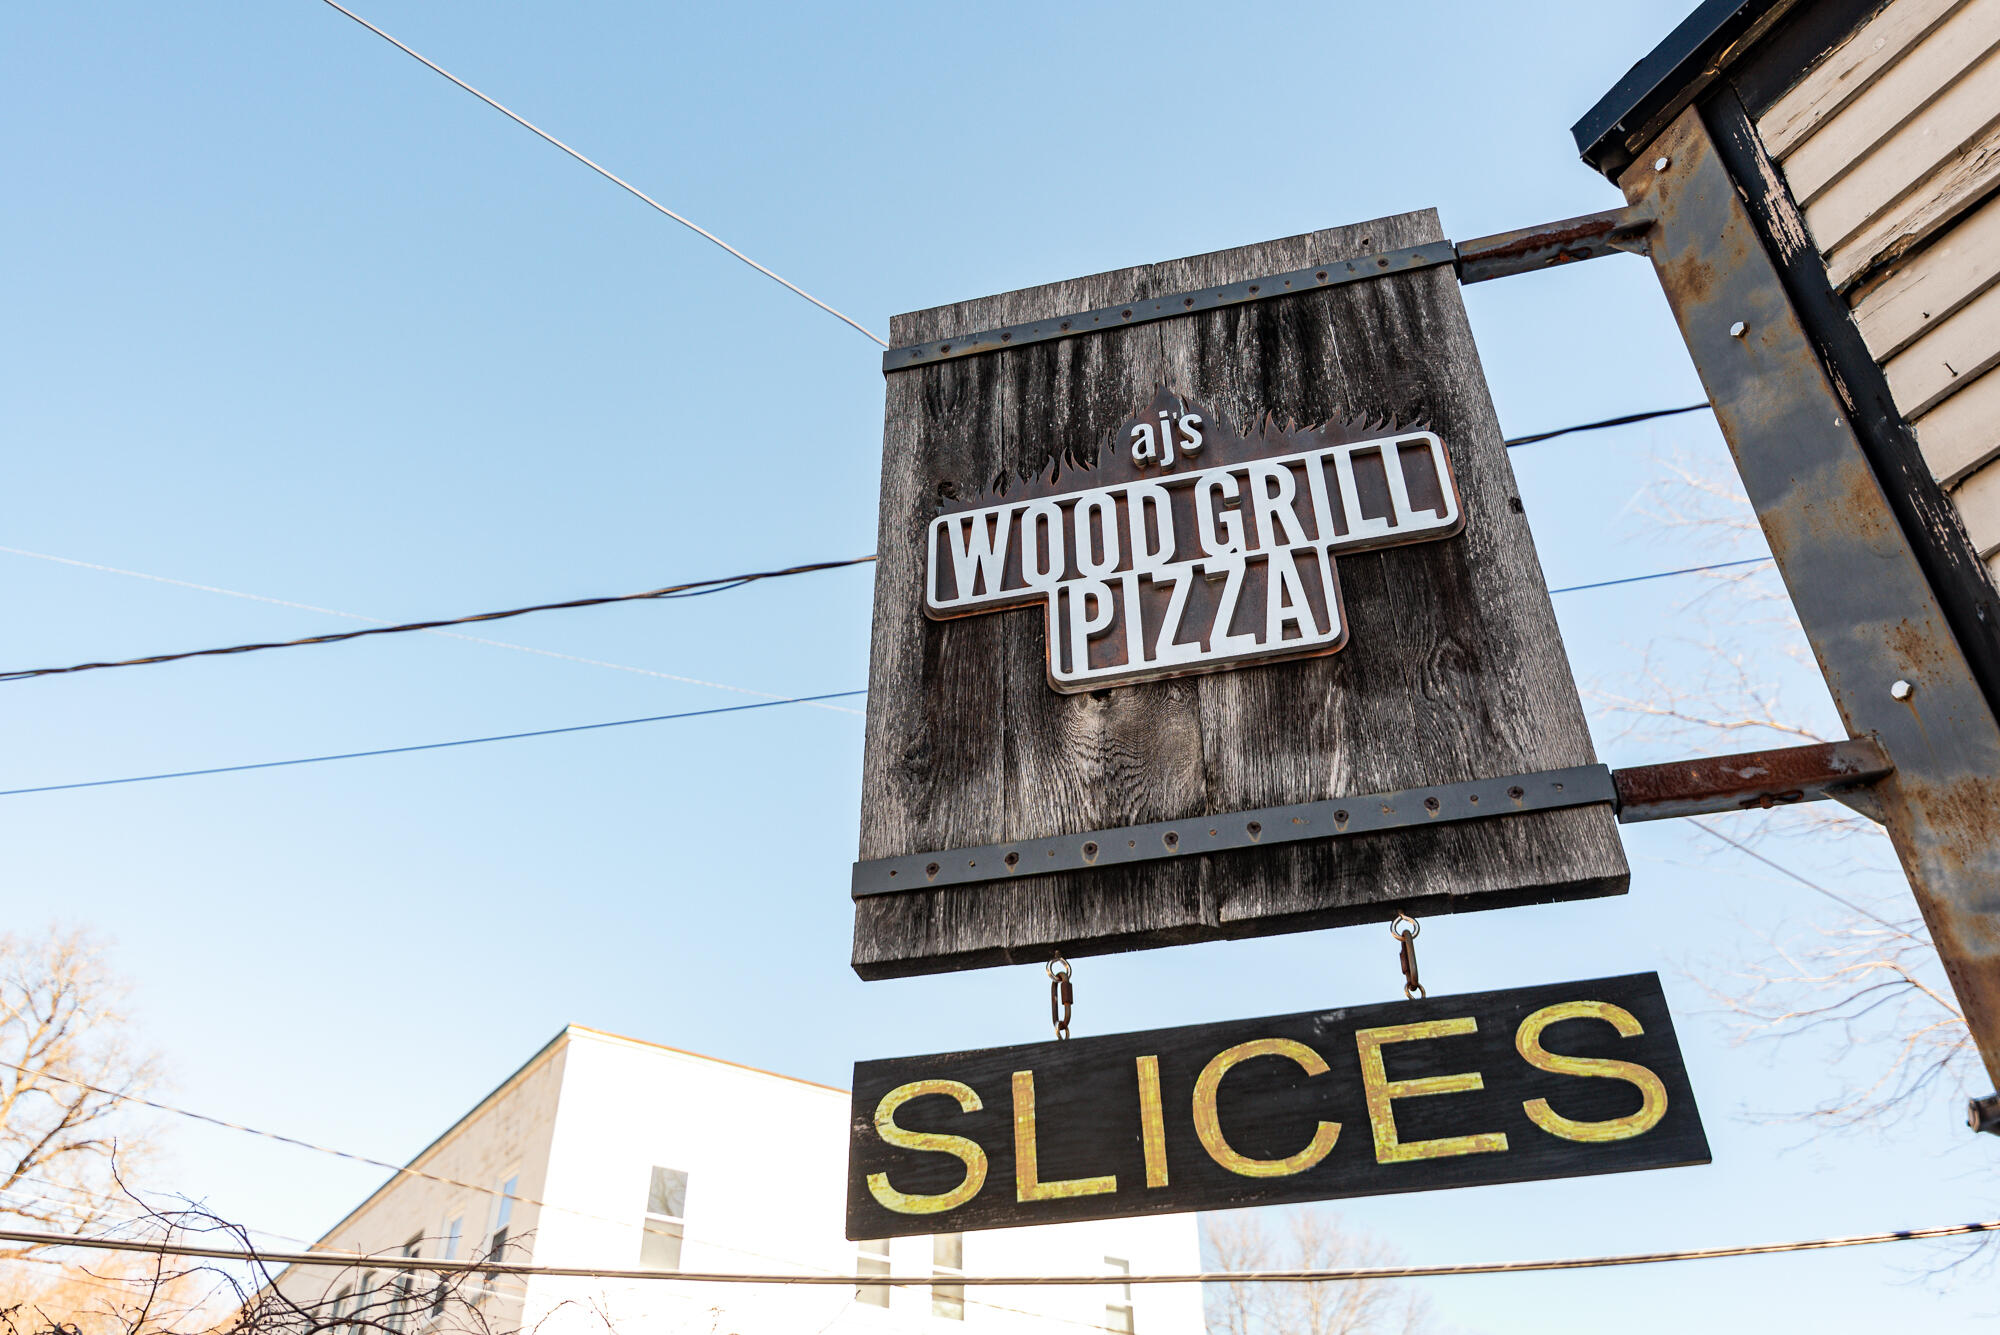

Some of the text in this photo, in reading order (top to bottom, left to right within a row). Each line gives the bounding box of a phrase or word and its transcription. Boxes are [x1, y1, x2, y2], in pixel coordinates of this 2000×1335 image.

[948, 434, 1438, 600] WOOD GRILL
[1067, 544, 1318, 676] PIZZA
[866, 1000, 1670, 1216] SLICES
